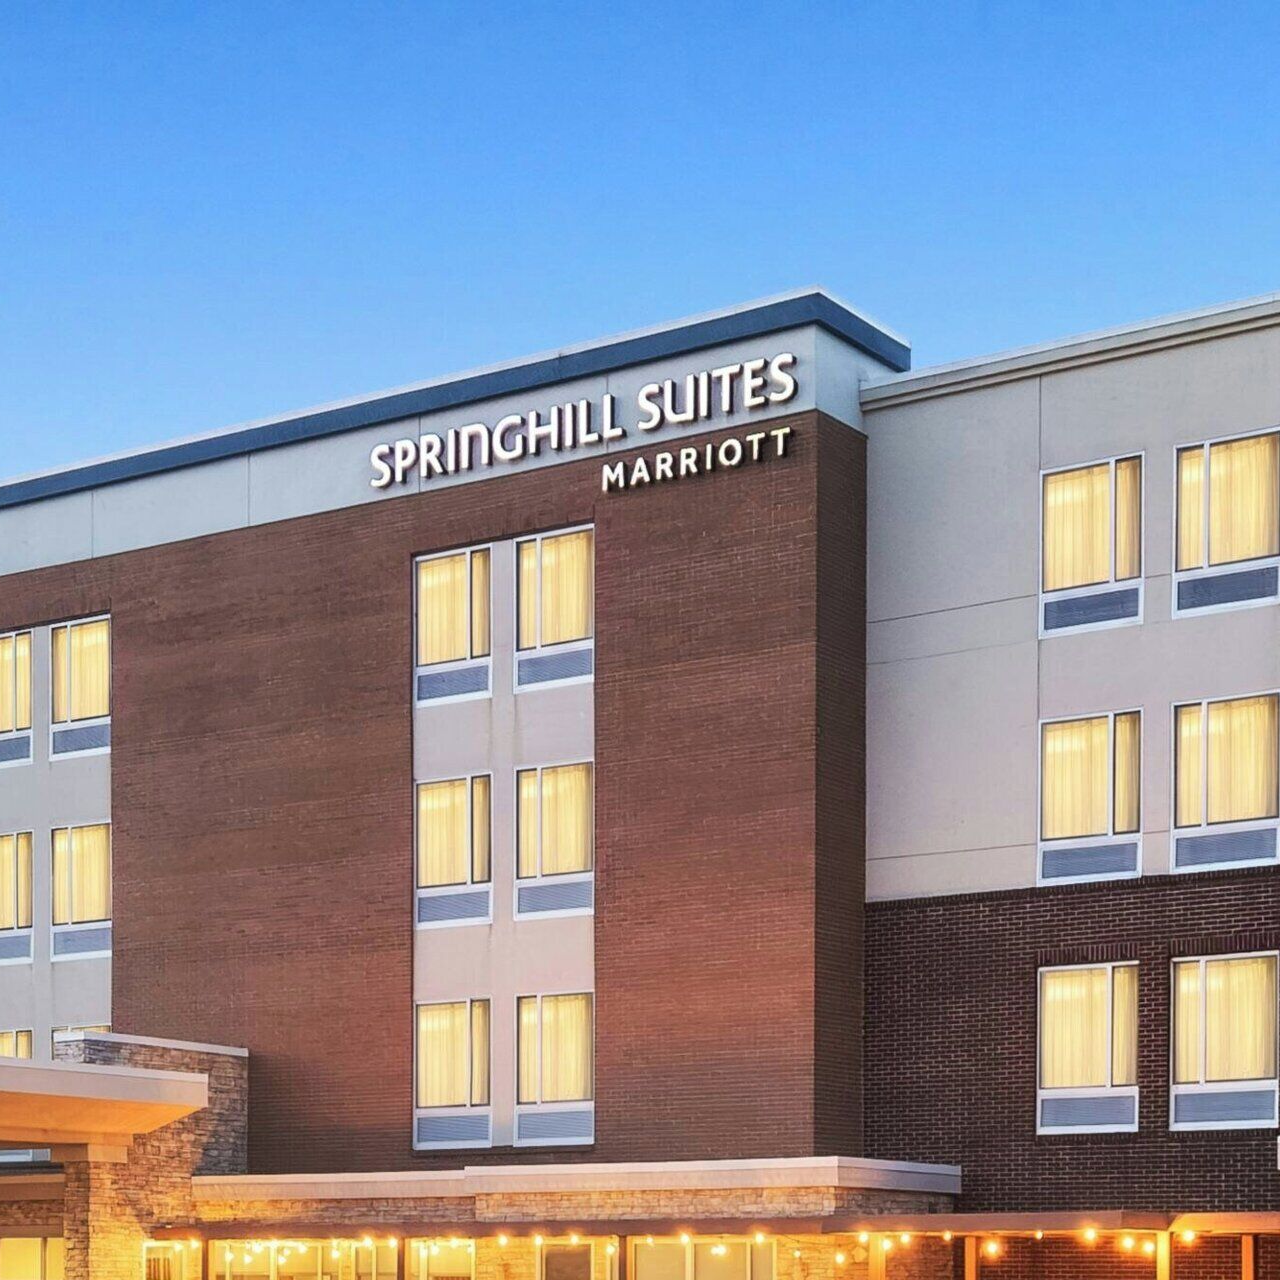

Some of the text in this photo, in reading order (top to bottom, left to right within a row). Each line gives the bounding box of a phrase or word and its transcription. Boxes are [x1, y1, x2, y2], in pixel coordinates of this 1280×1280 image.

[369, 352, 796, 489] SPRINGHILL SUITES
[602, 427, 791, 492] MARRIOTT
